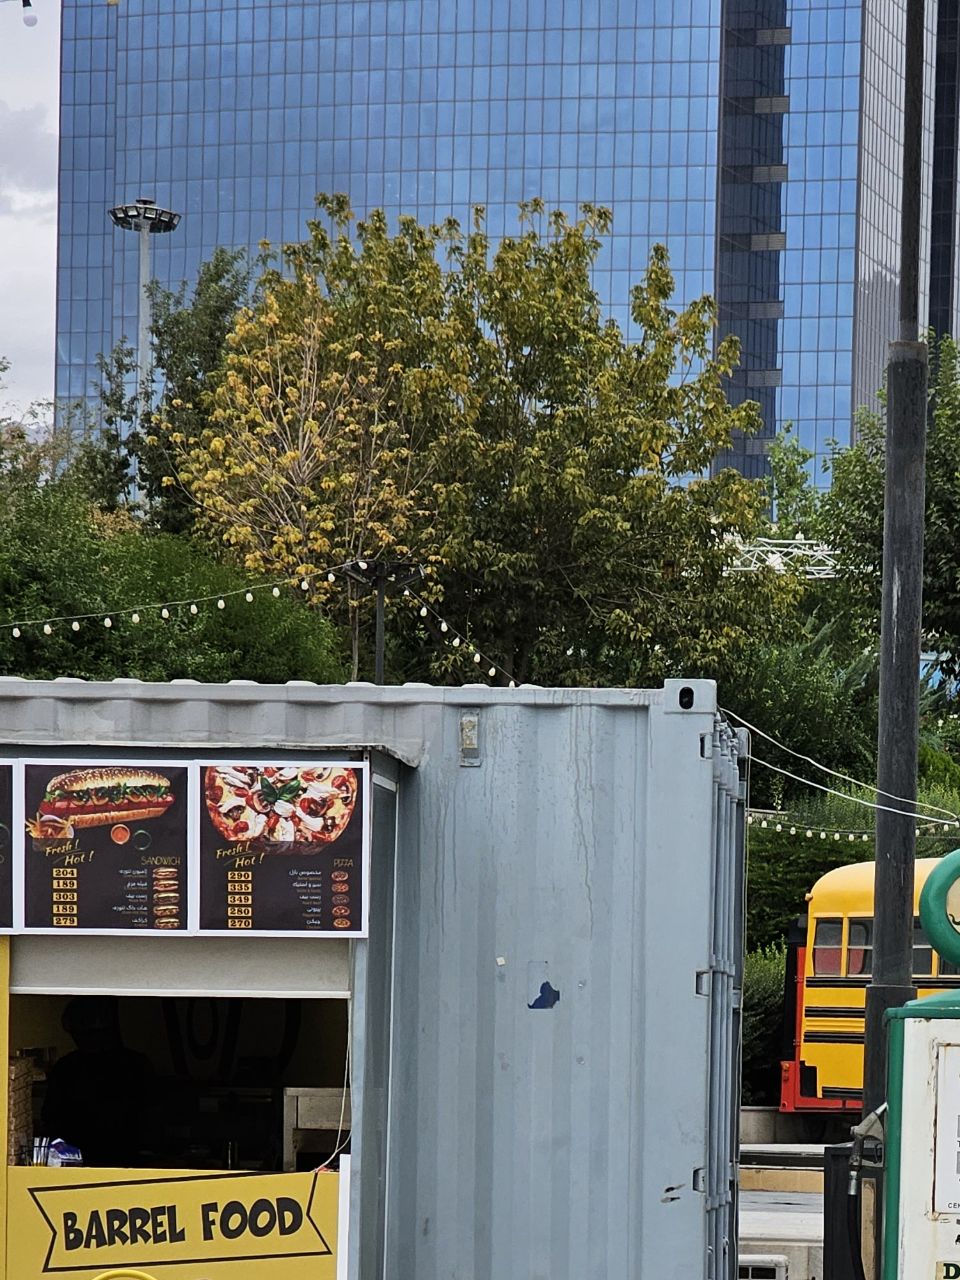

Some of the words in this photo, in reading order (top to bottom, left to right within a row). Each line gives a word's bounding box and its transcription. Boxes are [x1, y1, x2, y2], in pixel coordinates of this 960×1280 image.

[141, 855, 181, 866] SANDWICH
[333, 858, 354, 868] PIZZA
[54, 868, 76, 877] 204
[229, 872, 250, 881] 290
[55, 880, 76, 889] 189
[229, 883, 250, 892] 335
[54, 892, 76, 901] 303
[229, 895, 250, 904] 349
[55, 904, 76, 913] 189
[229, 907, 250, 916] 280
[54, 917, 76, 926] 279
[229, 919, 251, 928] 270
[63, 1204, 185, 1251] BARREL
[201, 1197, 303, 1241] FOOD
